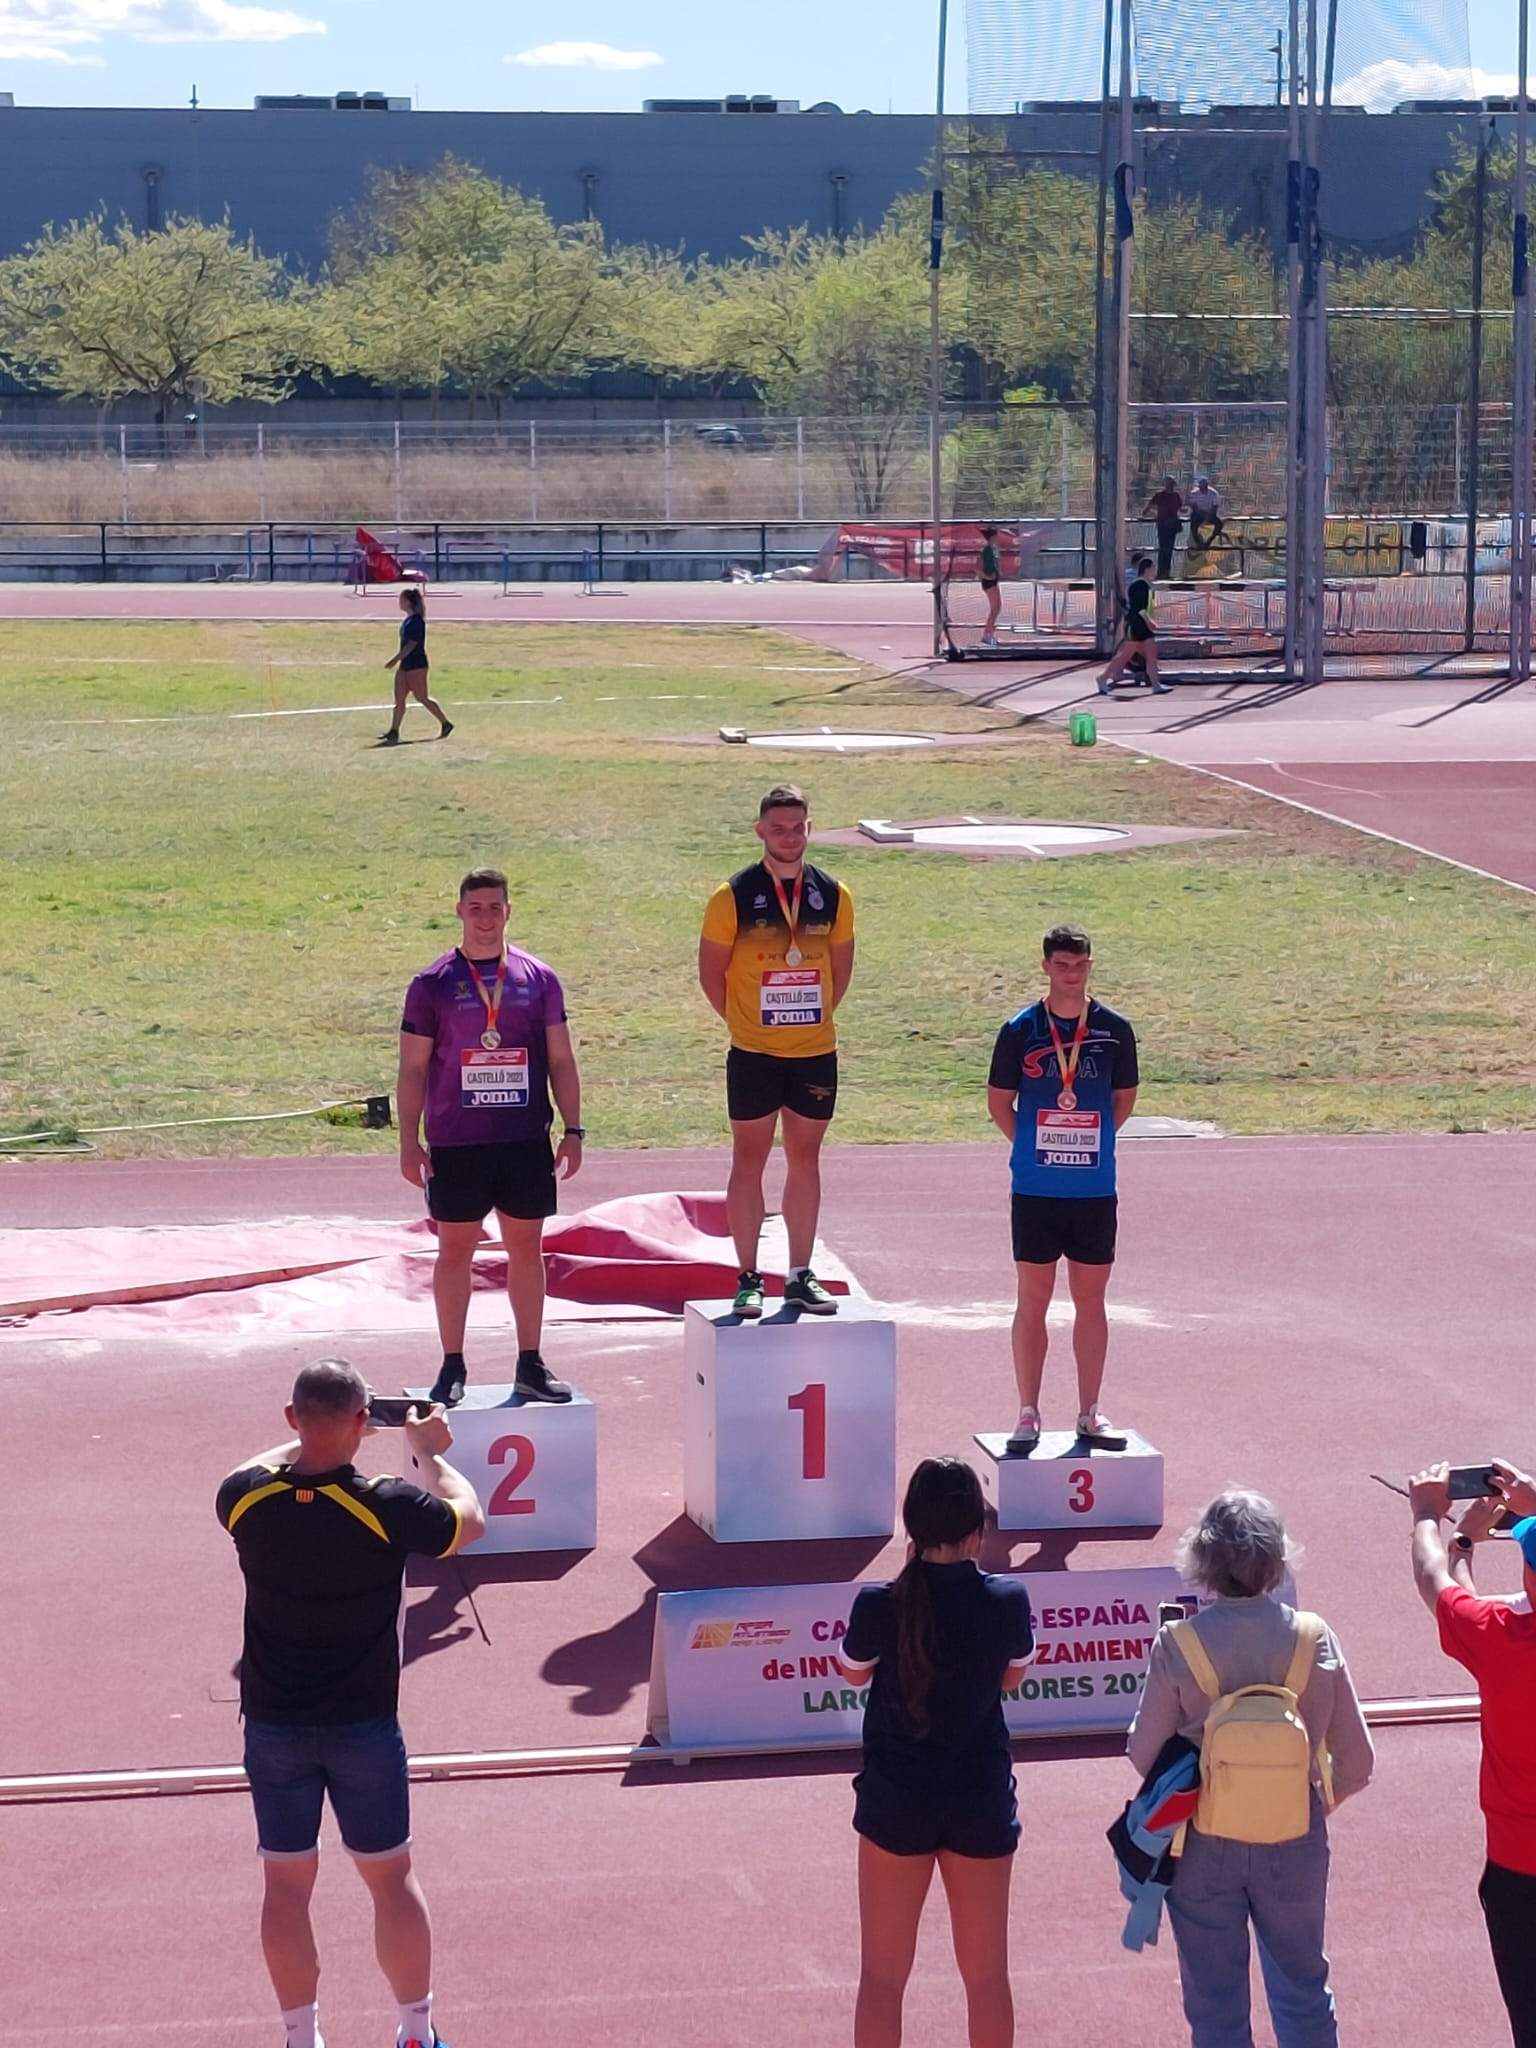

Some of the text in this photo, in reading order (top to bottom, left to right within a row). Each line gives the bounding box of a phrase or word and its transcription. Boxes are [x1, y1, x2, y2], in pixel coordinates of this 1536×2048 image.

[787, 1383, 826, 1480] 1
[487, 1434, 536, 1516] 2
[1068, 1469, 1095, 1513] 3
[1042, 1599, 1151, 1629] ESPAÑA
[762, 1658, 796, 1681] de
